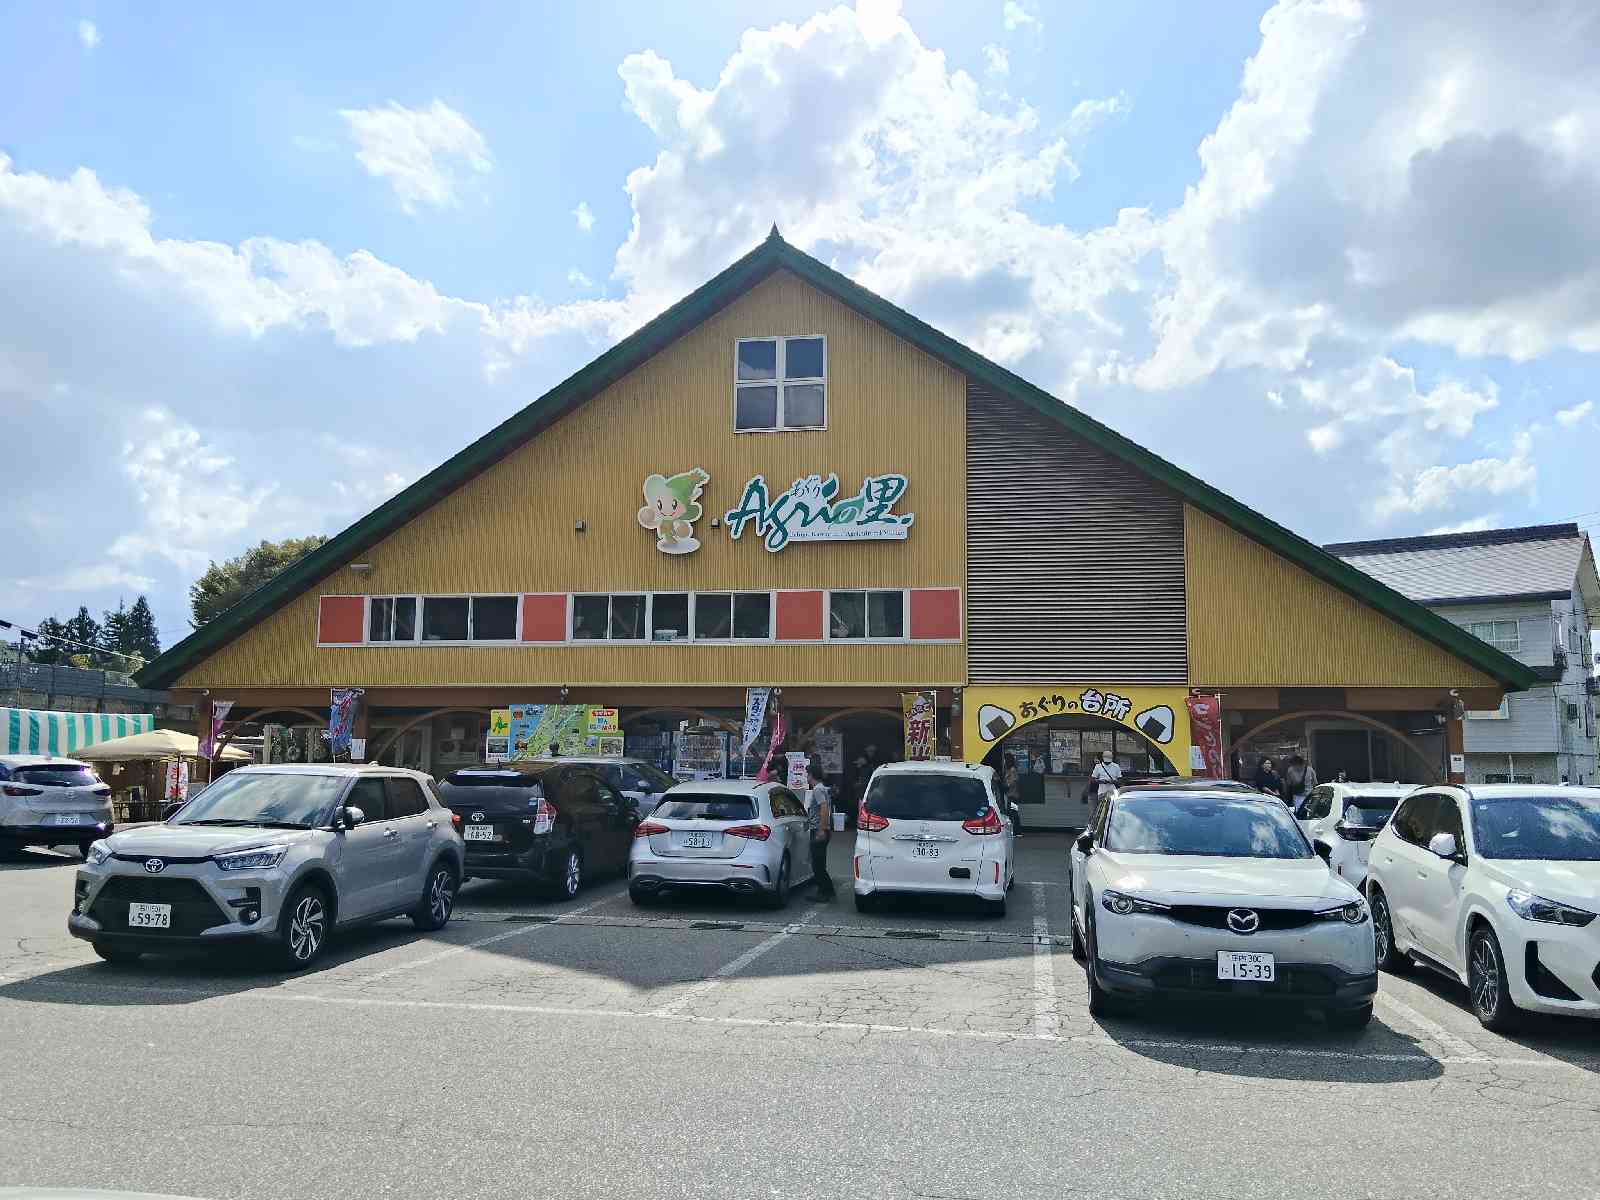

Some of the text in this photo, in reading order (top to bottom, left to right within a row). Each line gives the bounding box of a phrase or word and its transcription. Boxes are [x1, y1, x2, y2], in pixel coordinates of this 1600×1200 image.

[1019, 688, 1132, 721] あぐりの台所
[137, 912, 168, 926] 59-78
[1232, 963, 1272, 979] 15-39
